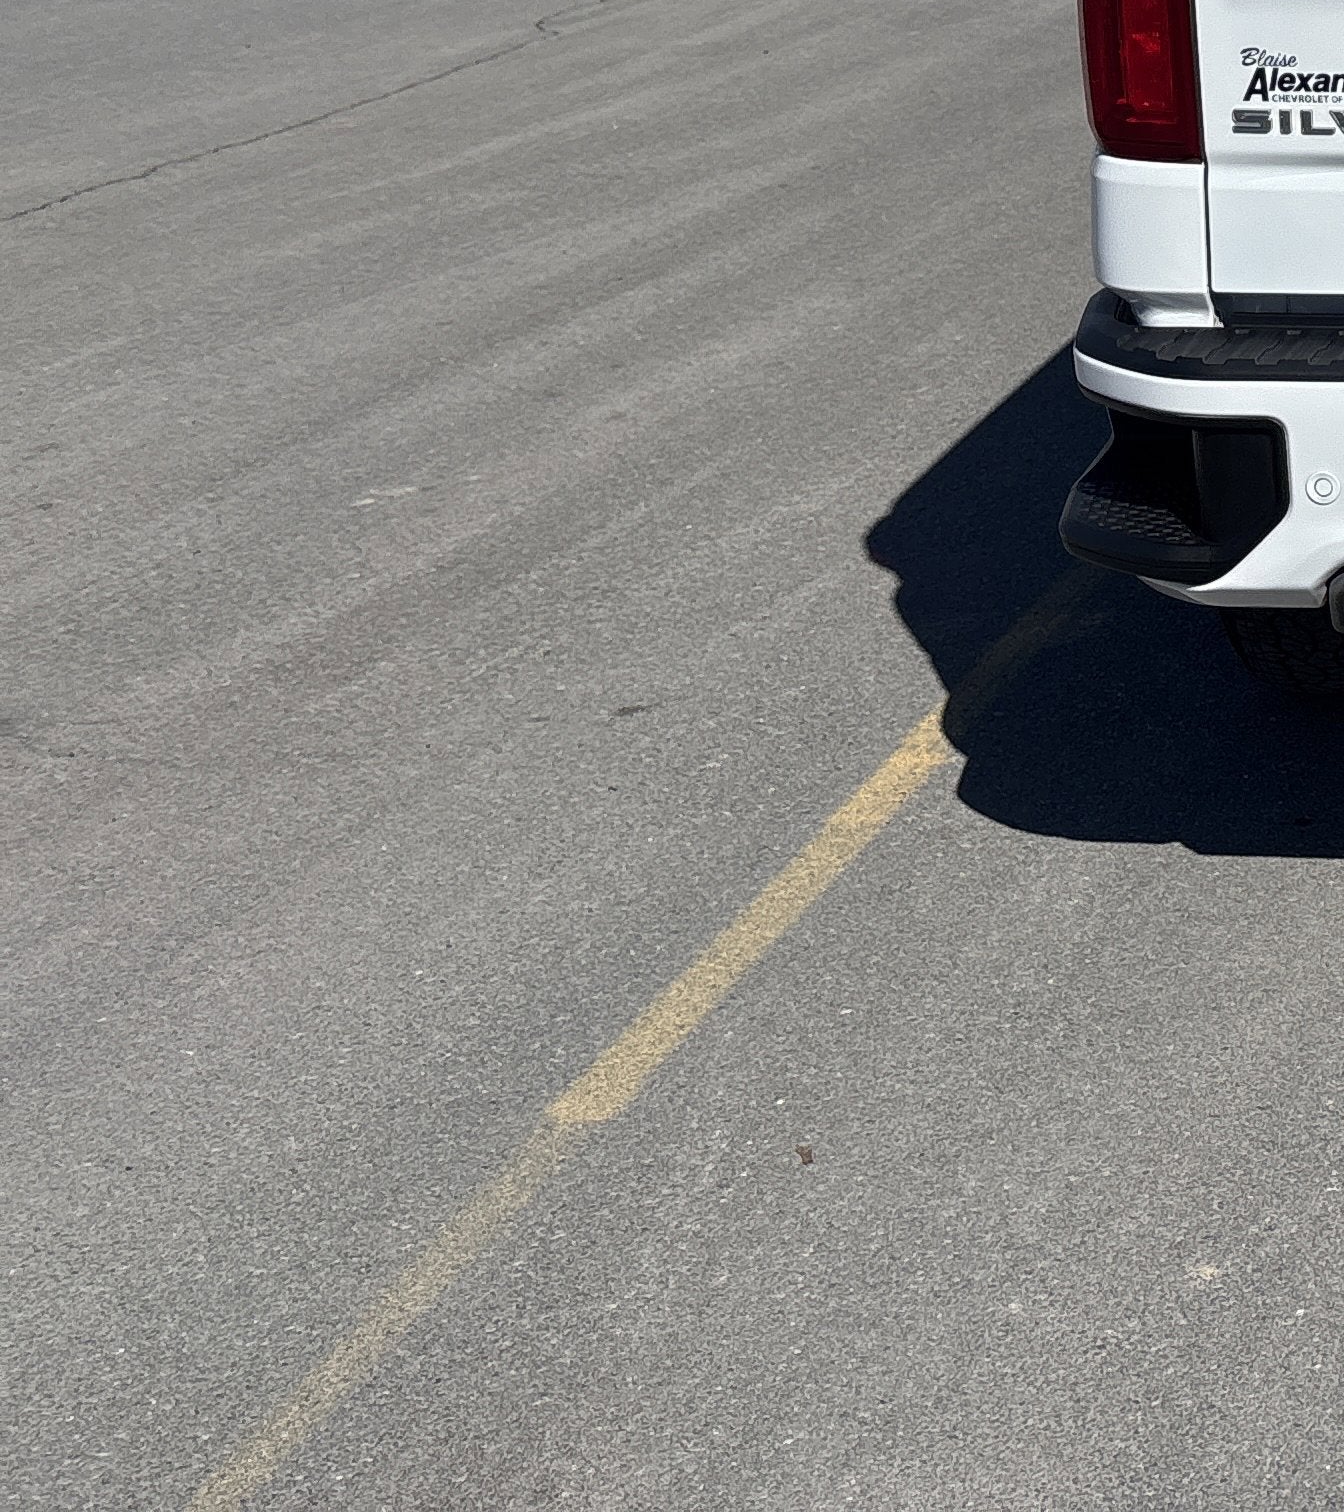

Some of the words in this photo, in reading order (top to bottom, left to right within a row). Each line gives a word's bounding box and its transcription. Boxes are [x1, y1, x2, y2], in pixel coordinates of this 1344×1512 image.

[1240, 47, 1298, 67] Blaise
[1272, 94, 1328, 103] CHEVROLET
[1331, 95, 1343, 103] OF
